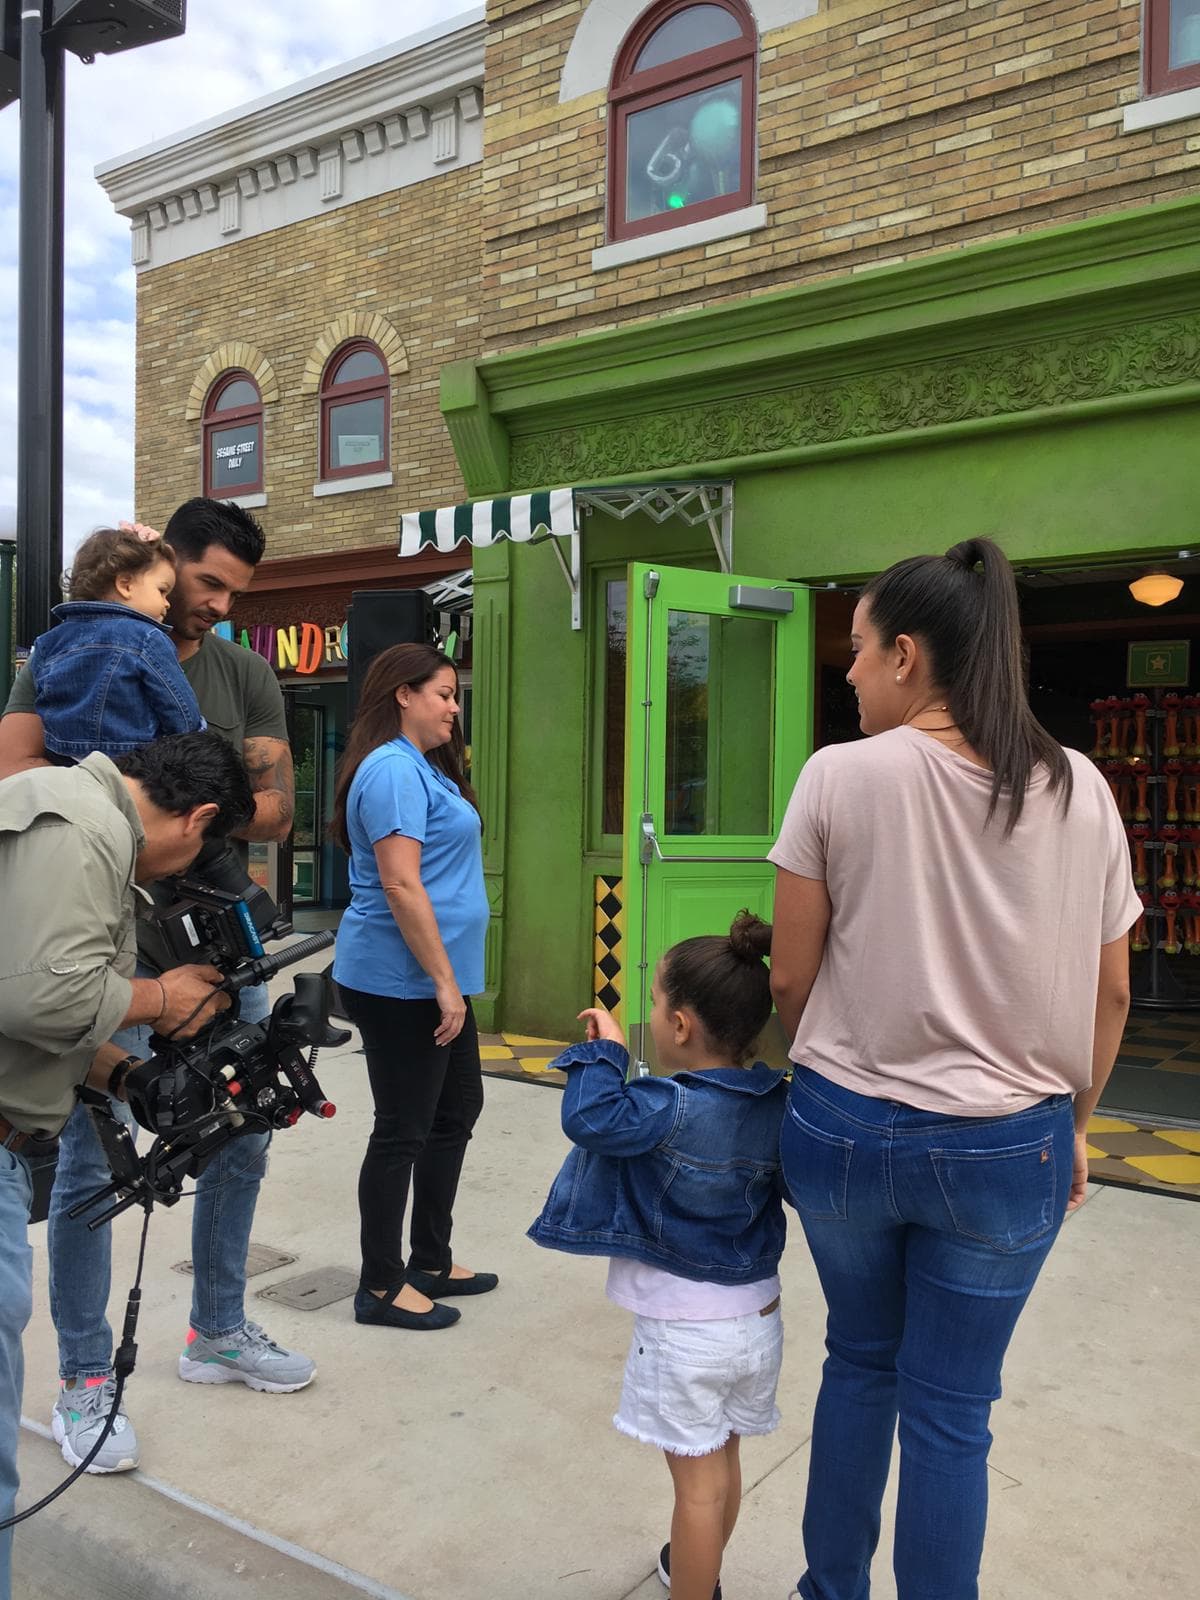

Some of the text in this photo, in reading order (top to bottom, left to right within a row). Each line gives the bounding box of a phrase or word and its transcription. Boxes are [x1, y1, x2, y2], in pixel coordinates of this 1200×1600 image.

[216, 441, 255, 459] SESAME STREET
[228, 457, 243, 469] DAILY
